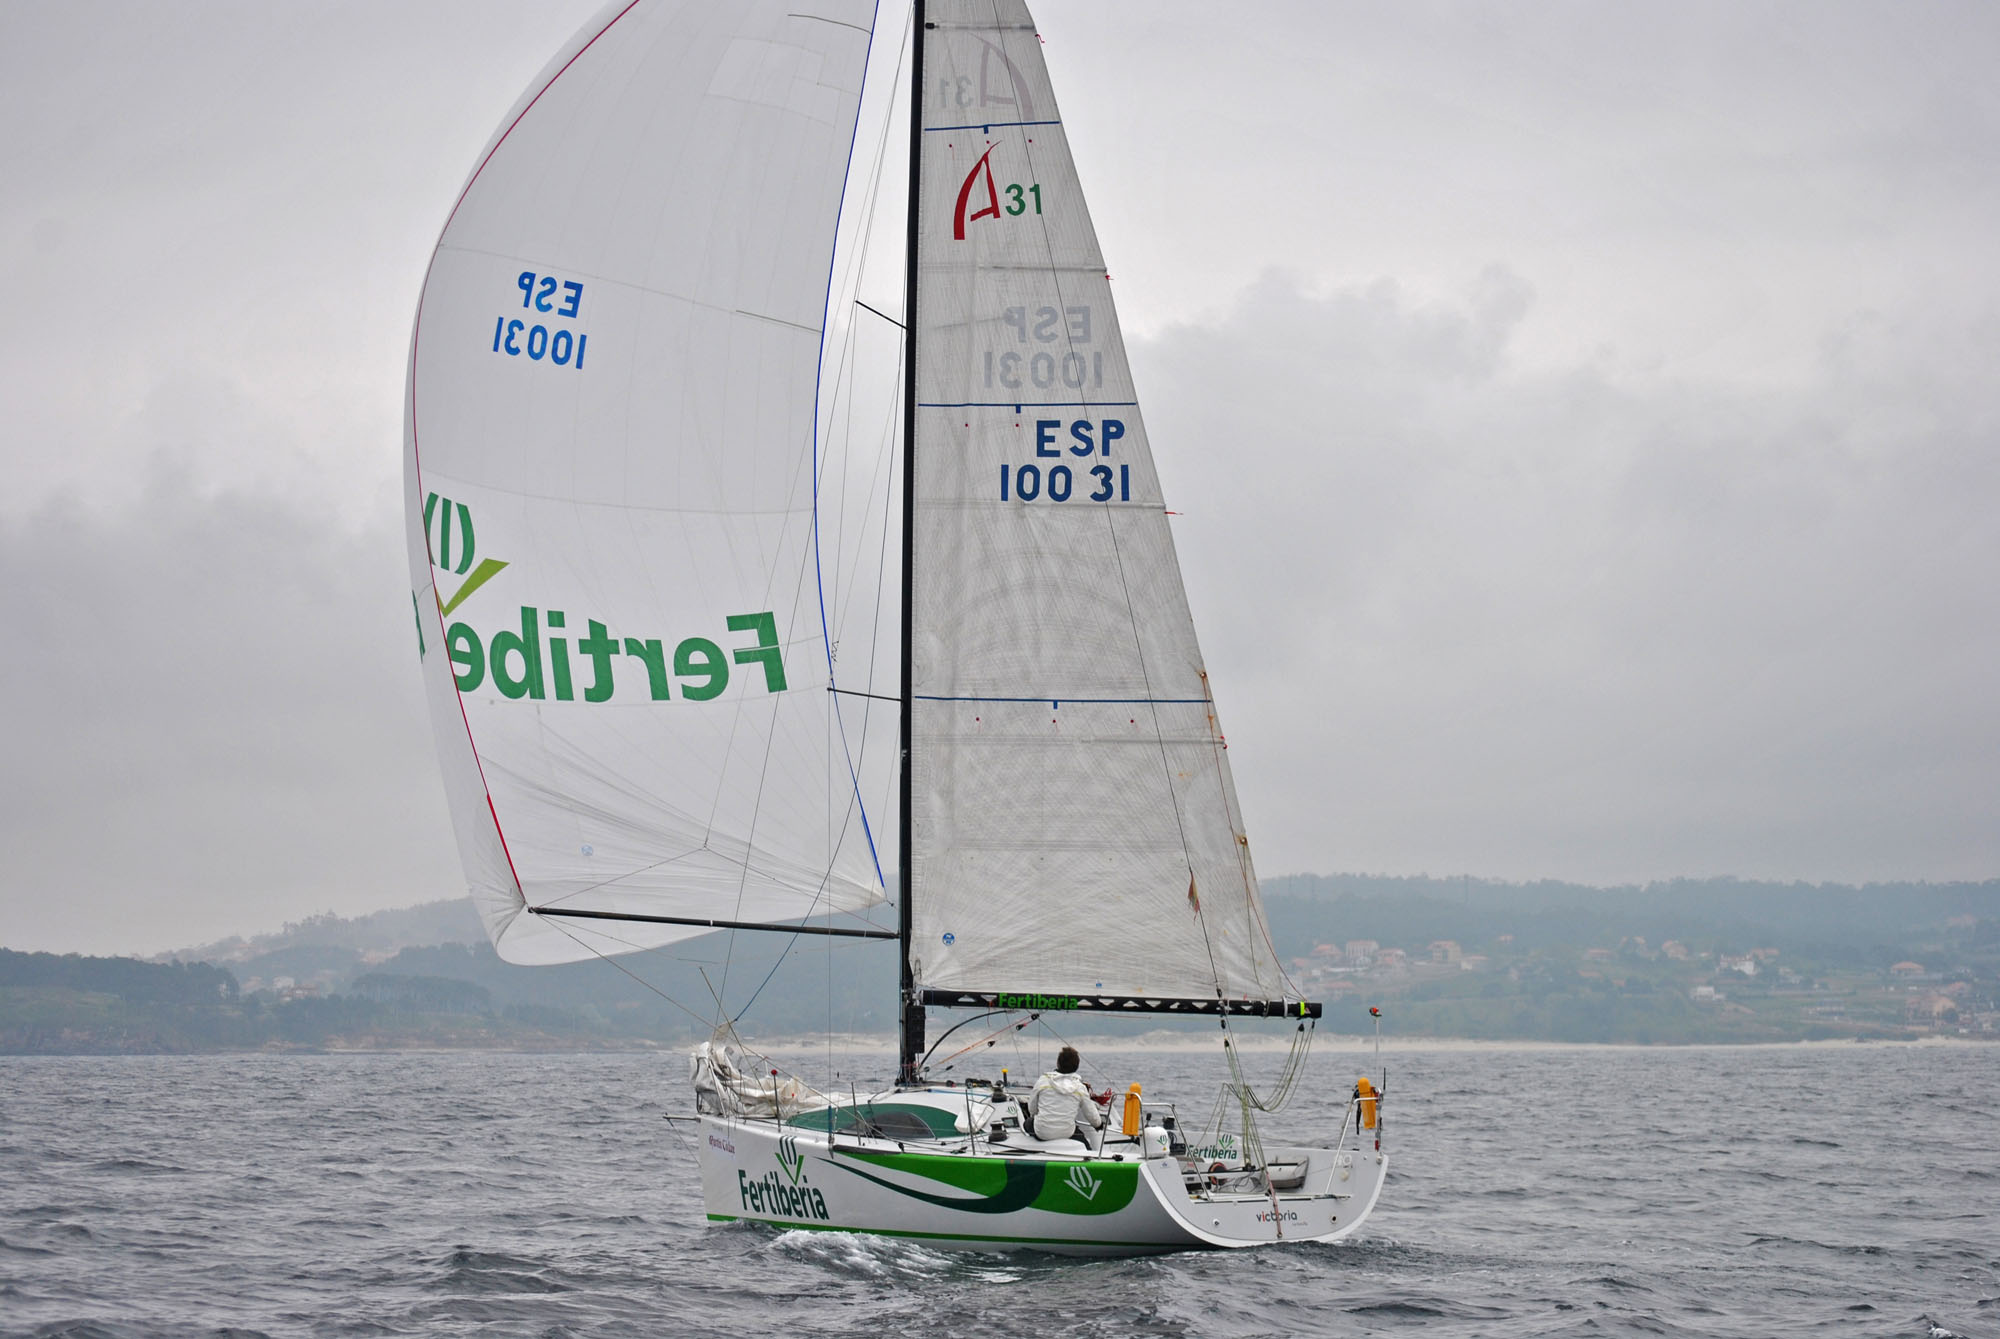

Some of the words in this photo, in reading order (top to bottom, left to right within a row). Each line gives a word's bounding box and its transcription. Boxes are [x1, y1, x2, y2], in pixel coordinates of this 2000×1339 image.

[1036, 419, 1126, 458] ESP
[999, 993, 1078, 1010] Fertiberia
[1186, 1144, 1238, 1160] Fertiberia
[738, 1169, 830, 1220] Fertiberia
[1256, 1210, 1298, 1223] victoria
